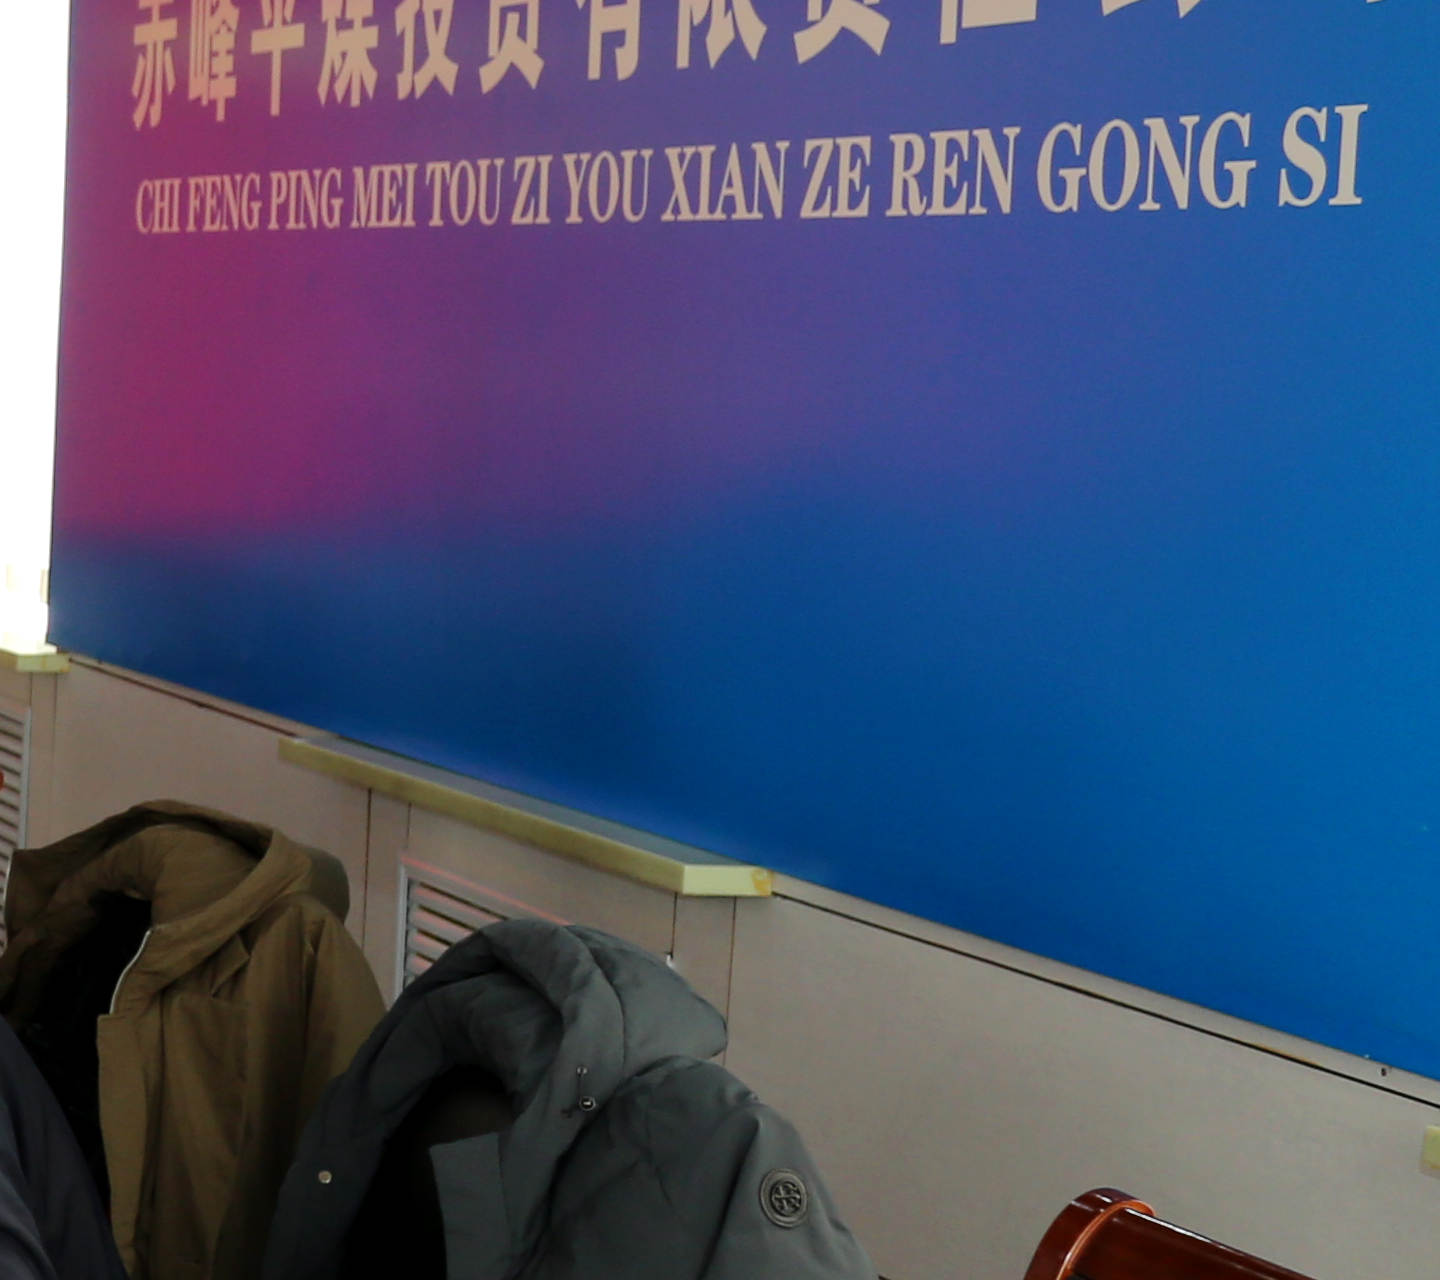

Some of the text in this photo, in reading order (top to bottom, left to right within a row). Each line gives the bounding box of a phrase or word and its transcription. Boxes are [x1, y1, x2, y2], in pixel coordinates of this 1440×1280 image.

[135, 103, 1369, 234] CHI FENG PING MEI TOU ZI YOU XIAN ZE REN GONG SI
